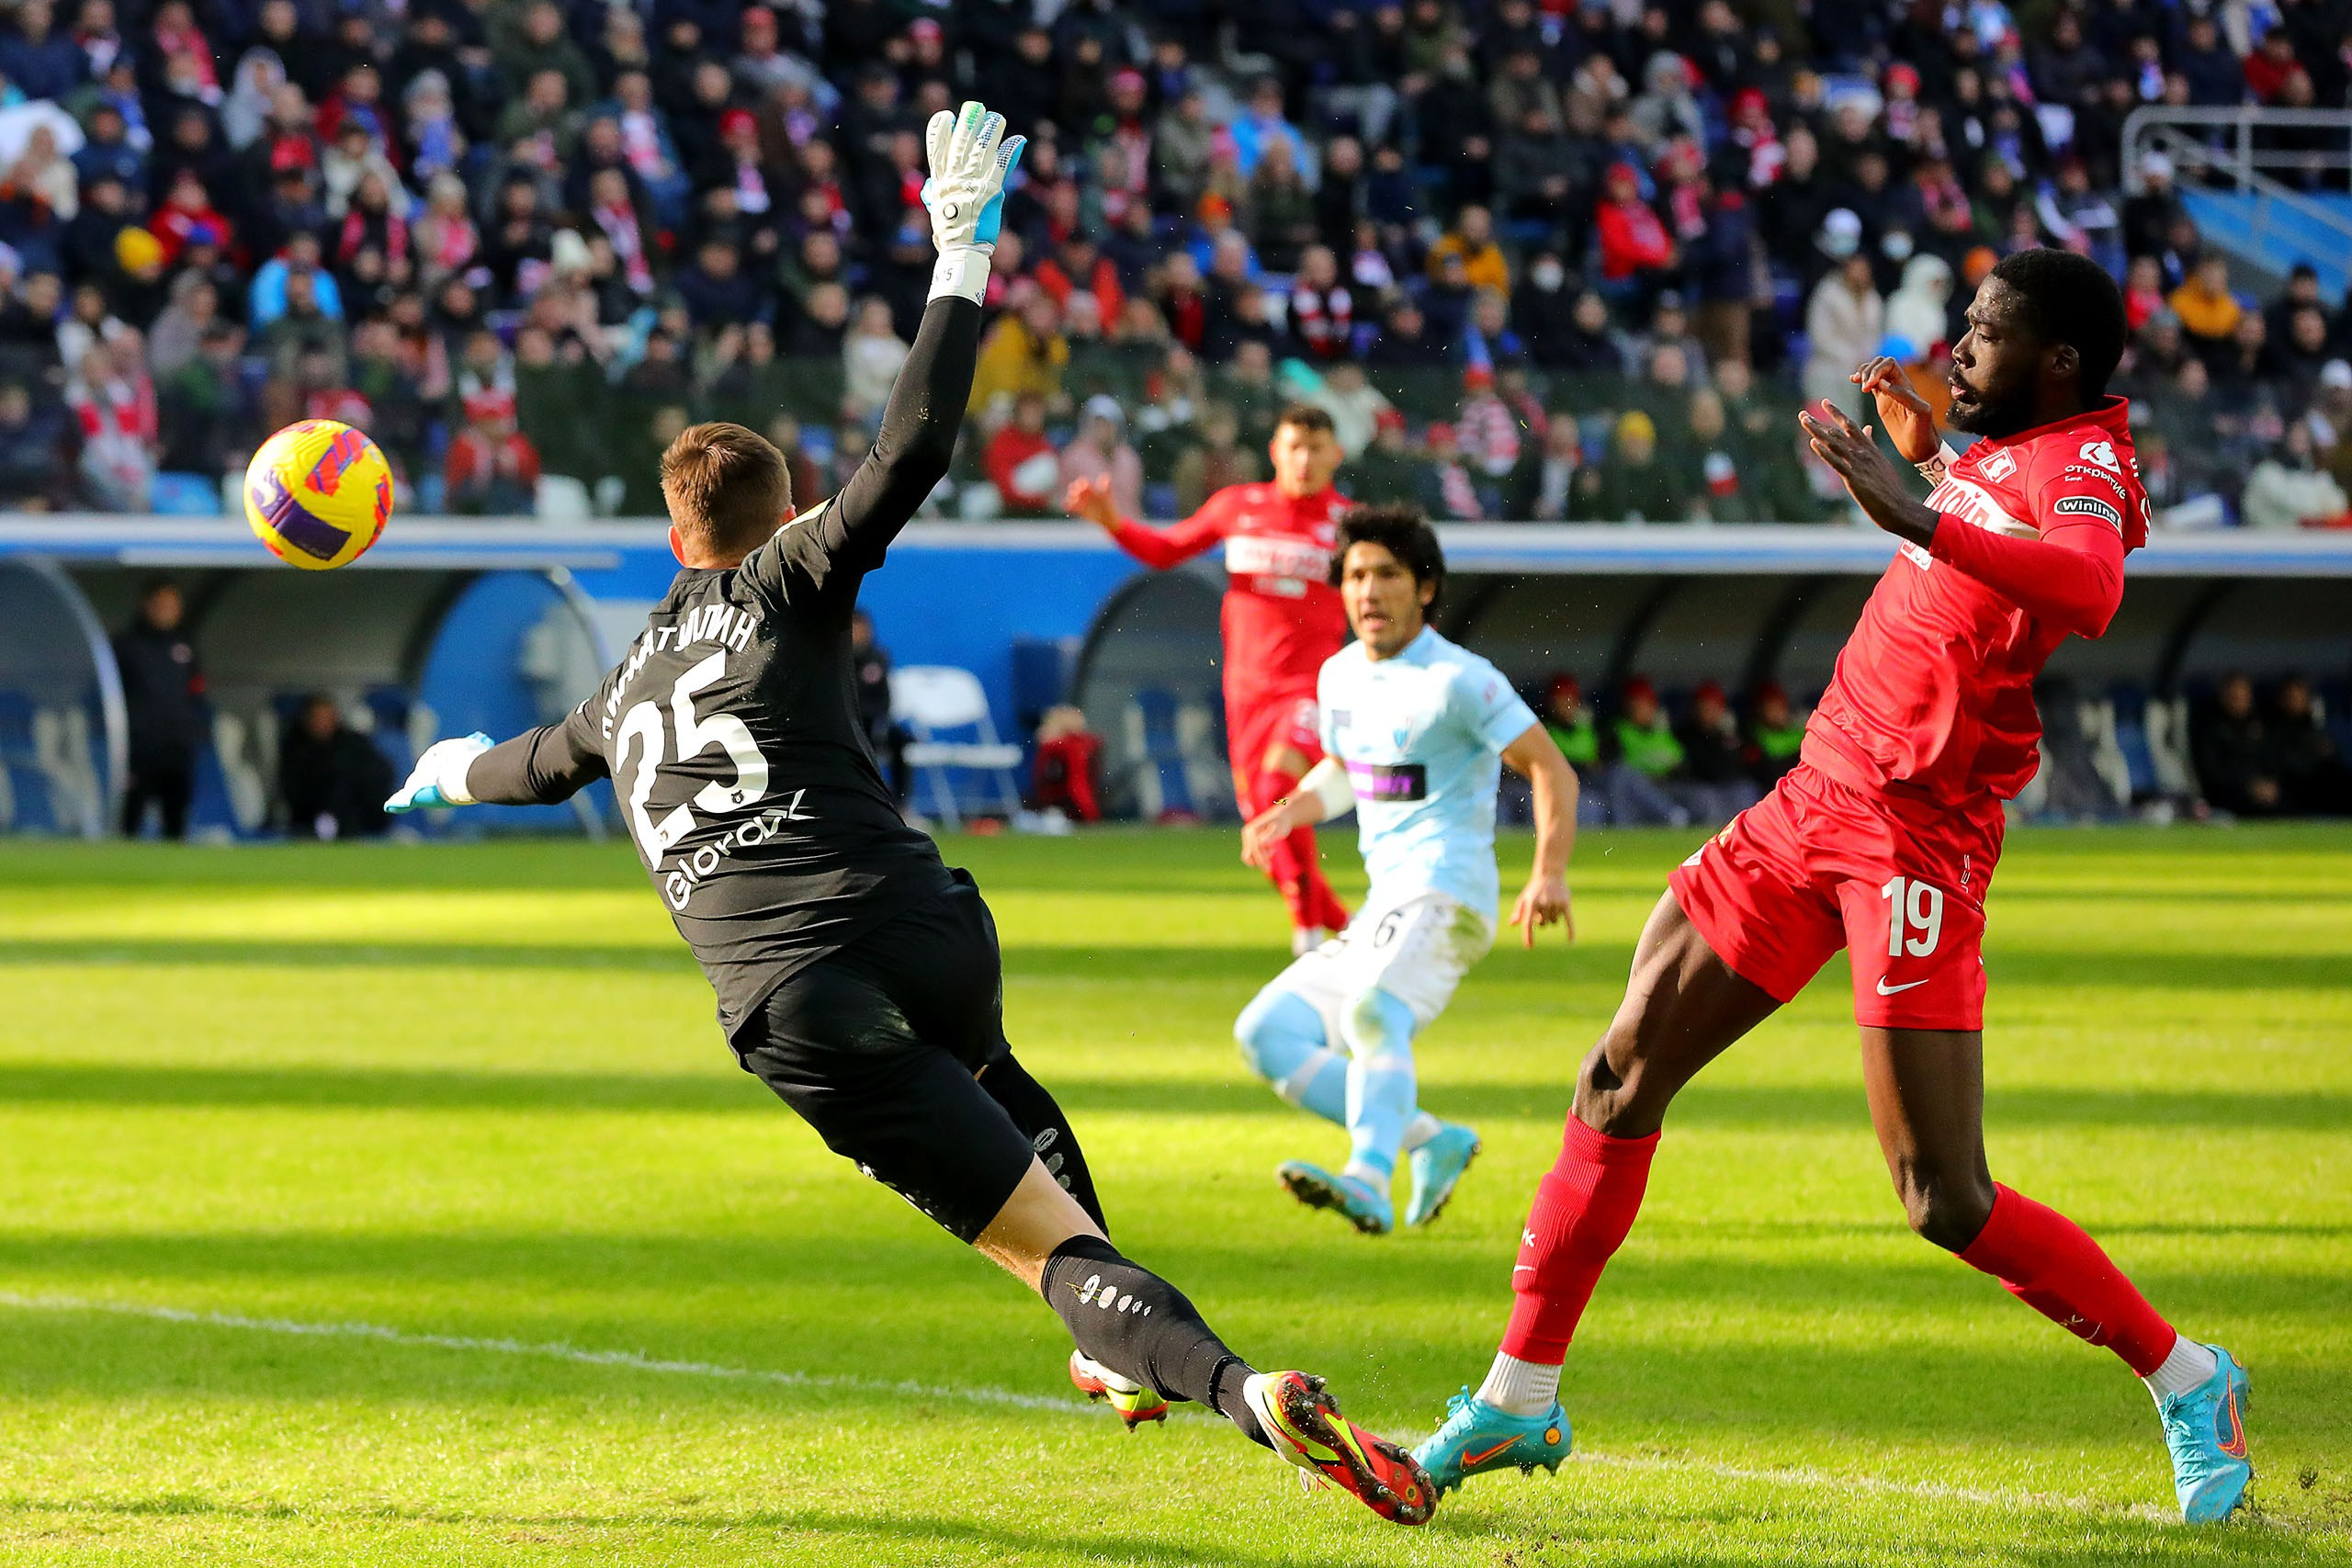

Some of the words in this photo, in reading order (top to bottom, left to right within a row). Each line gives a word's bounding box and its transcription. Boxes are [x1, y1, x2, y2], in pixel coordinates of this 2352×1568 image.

[2063, 501, 2116, 523] Winline
[616, 647, 769, 872] 25
[1881, 875, 1944, 957] 19
